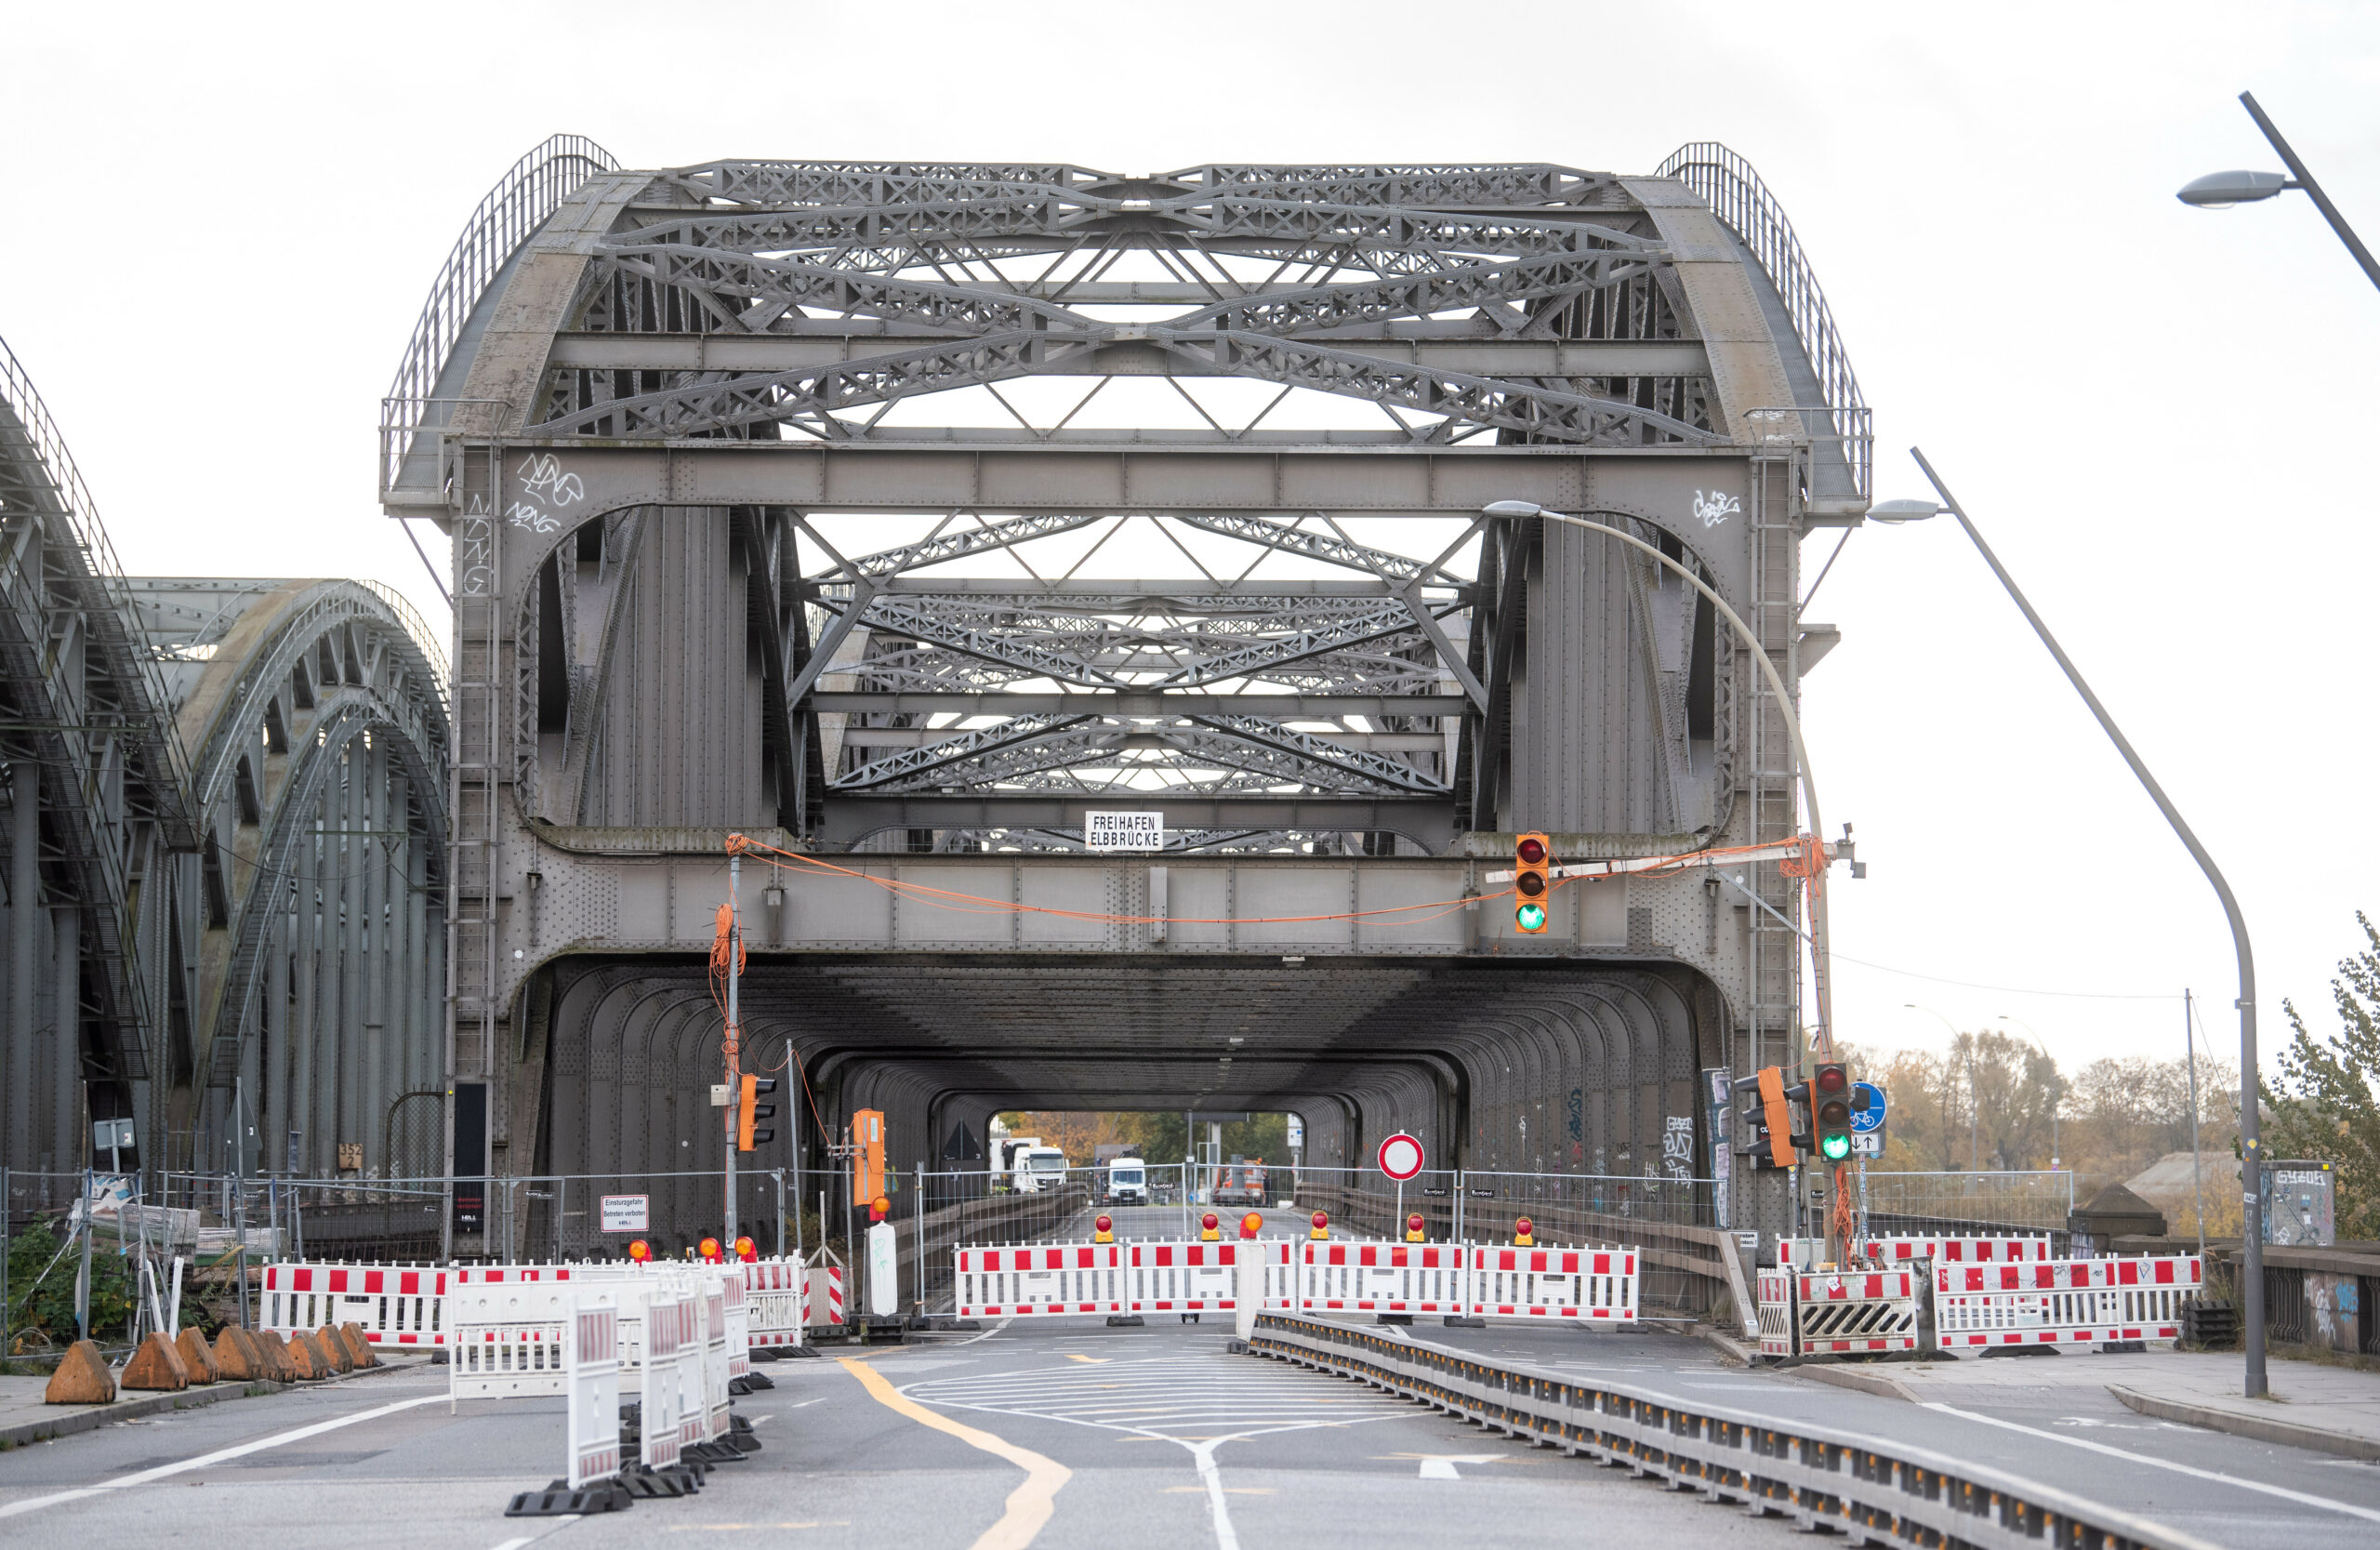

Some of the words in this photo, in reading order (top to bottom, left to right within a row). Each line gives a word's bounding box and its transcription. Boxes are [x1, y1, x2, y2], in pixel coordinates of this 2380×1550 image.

[1093, 815, 1156, 830] FREIHAFEN
[1091, 830, 1159, 847] ELBBRÜCKE
[340, 1145, 362, 1156] 352
[348, 1156, 354, 1167] 2
[605, 1199, 643, 1207] Einsturzgefahr
